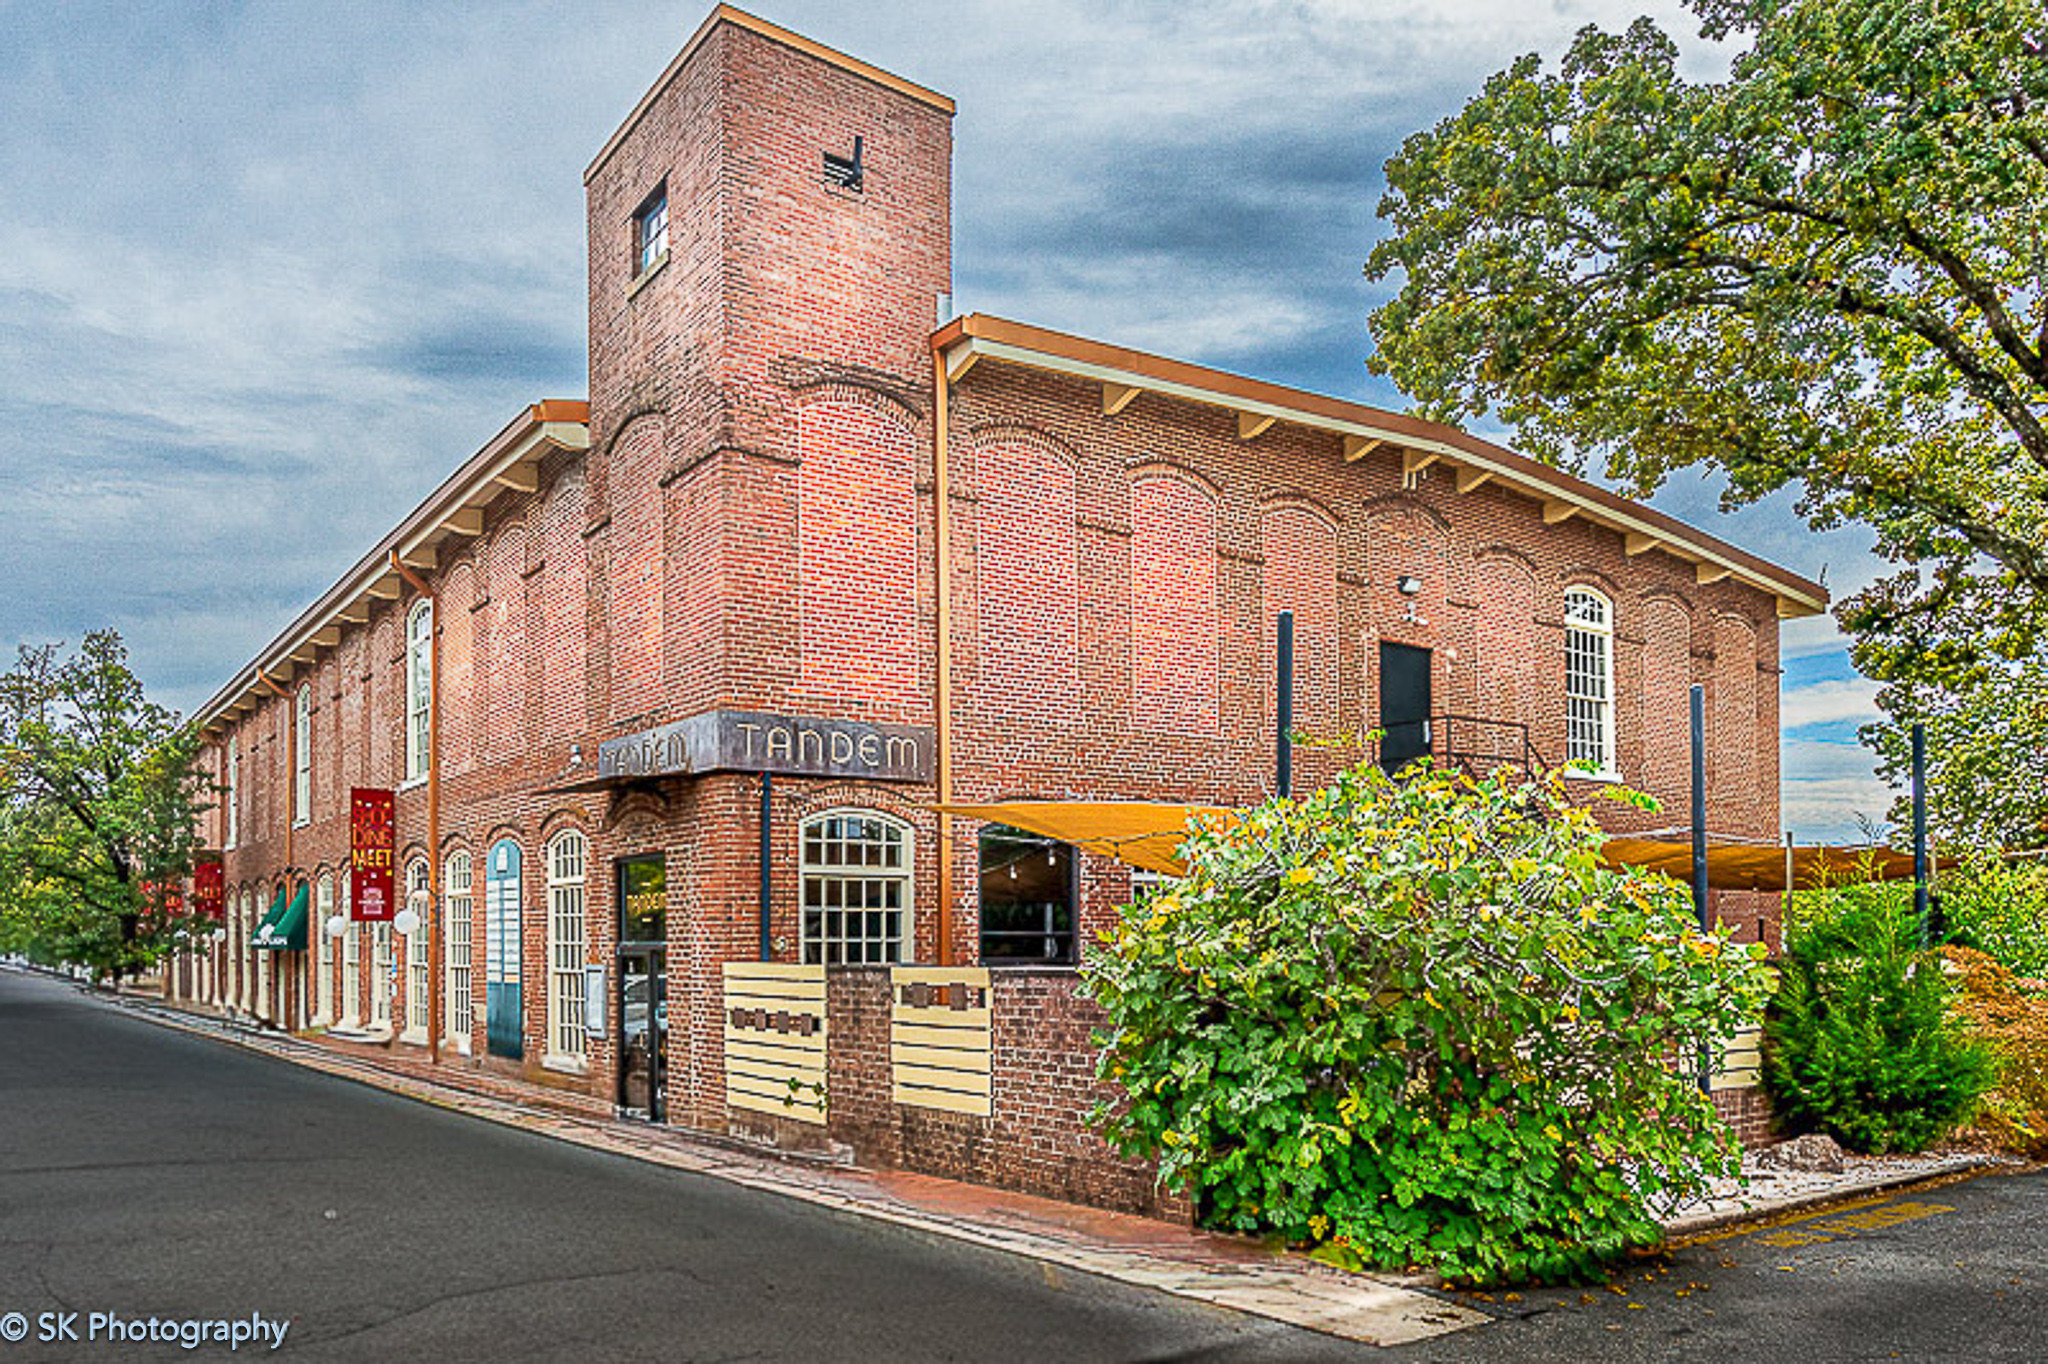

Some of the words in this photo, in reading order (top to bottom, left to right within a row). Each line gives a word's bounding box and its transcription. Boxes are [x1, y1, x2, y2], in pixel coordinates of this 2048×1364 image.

[737, 723, 918, 768] TANDEM
[352, 807, 393, 825] SHOP
[352, 847, 393, 866] MEET
